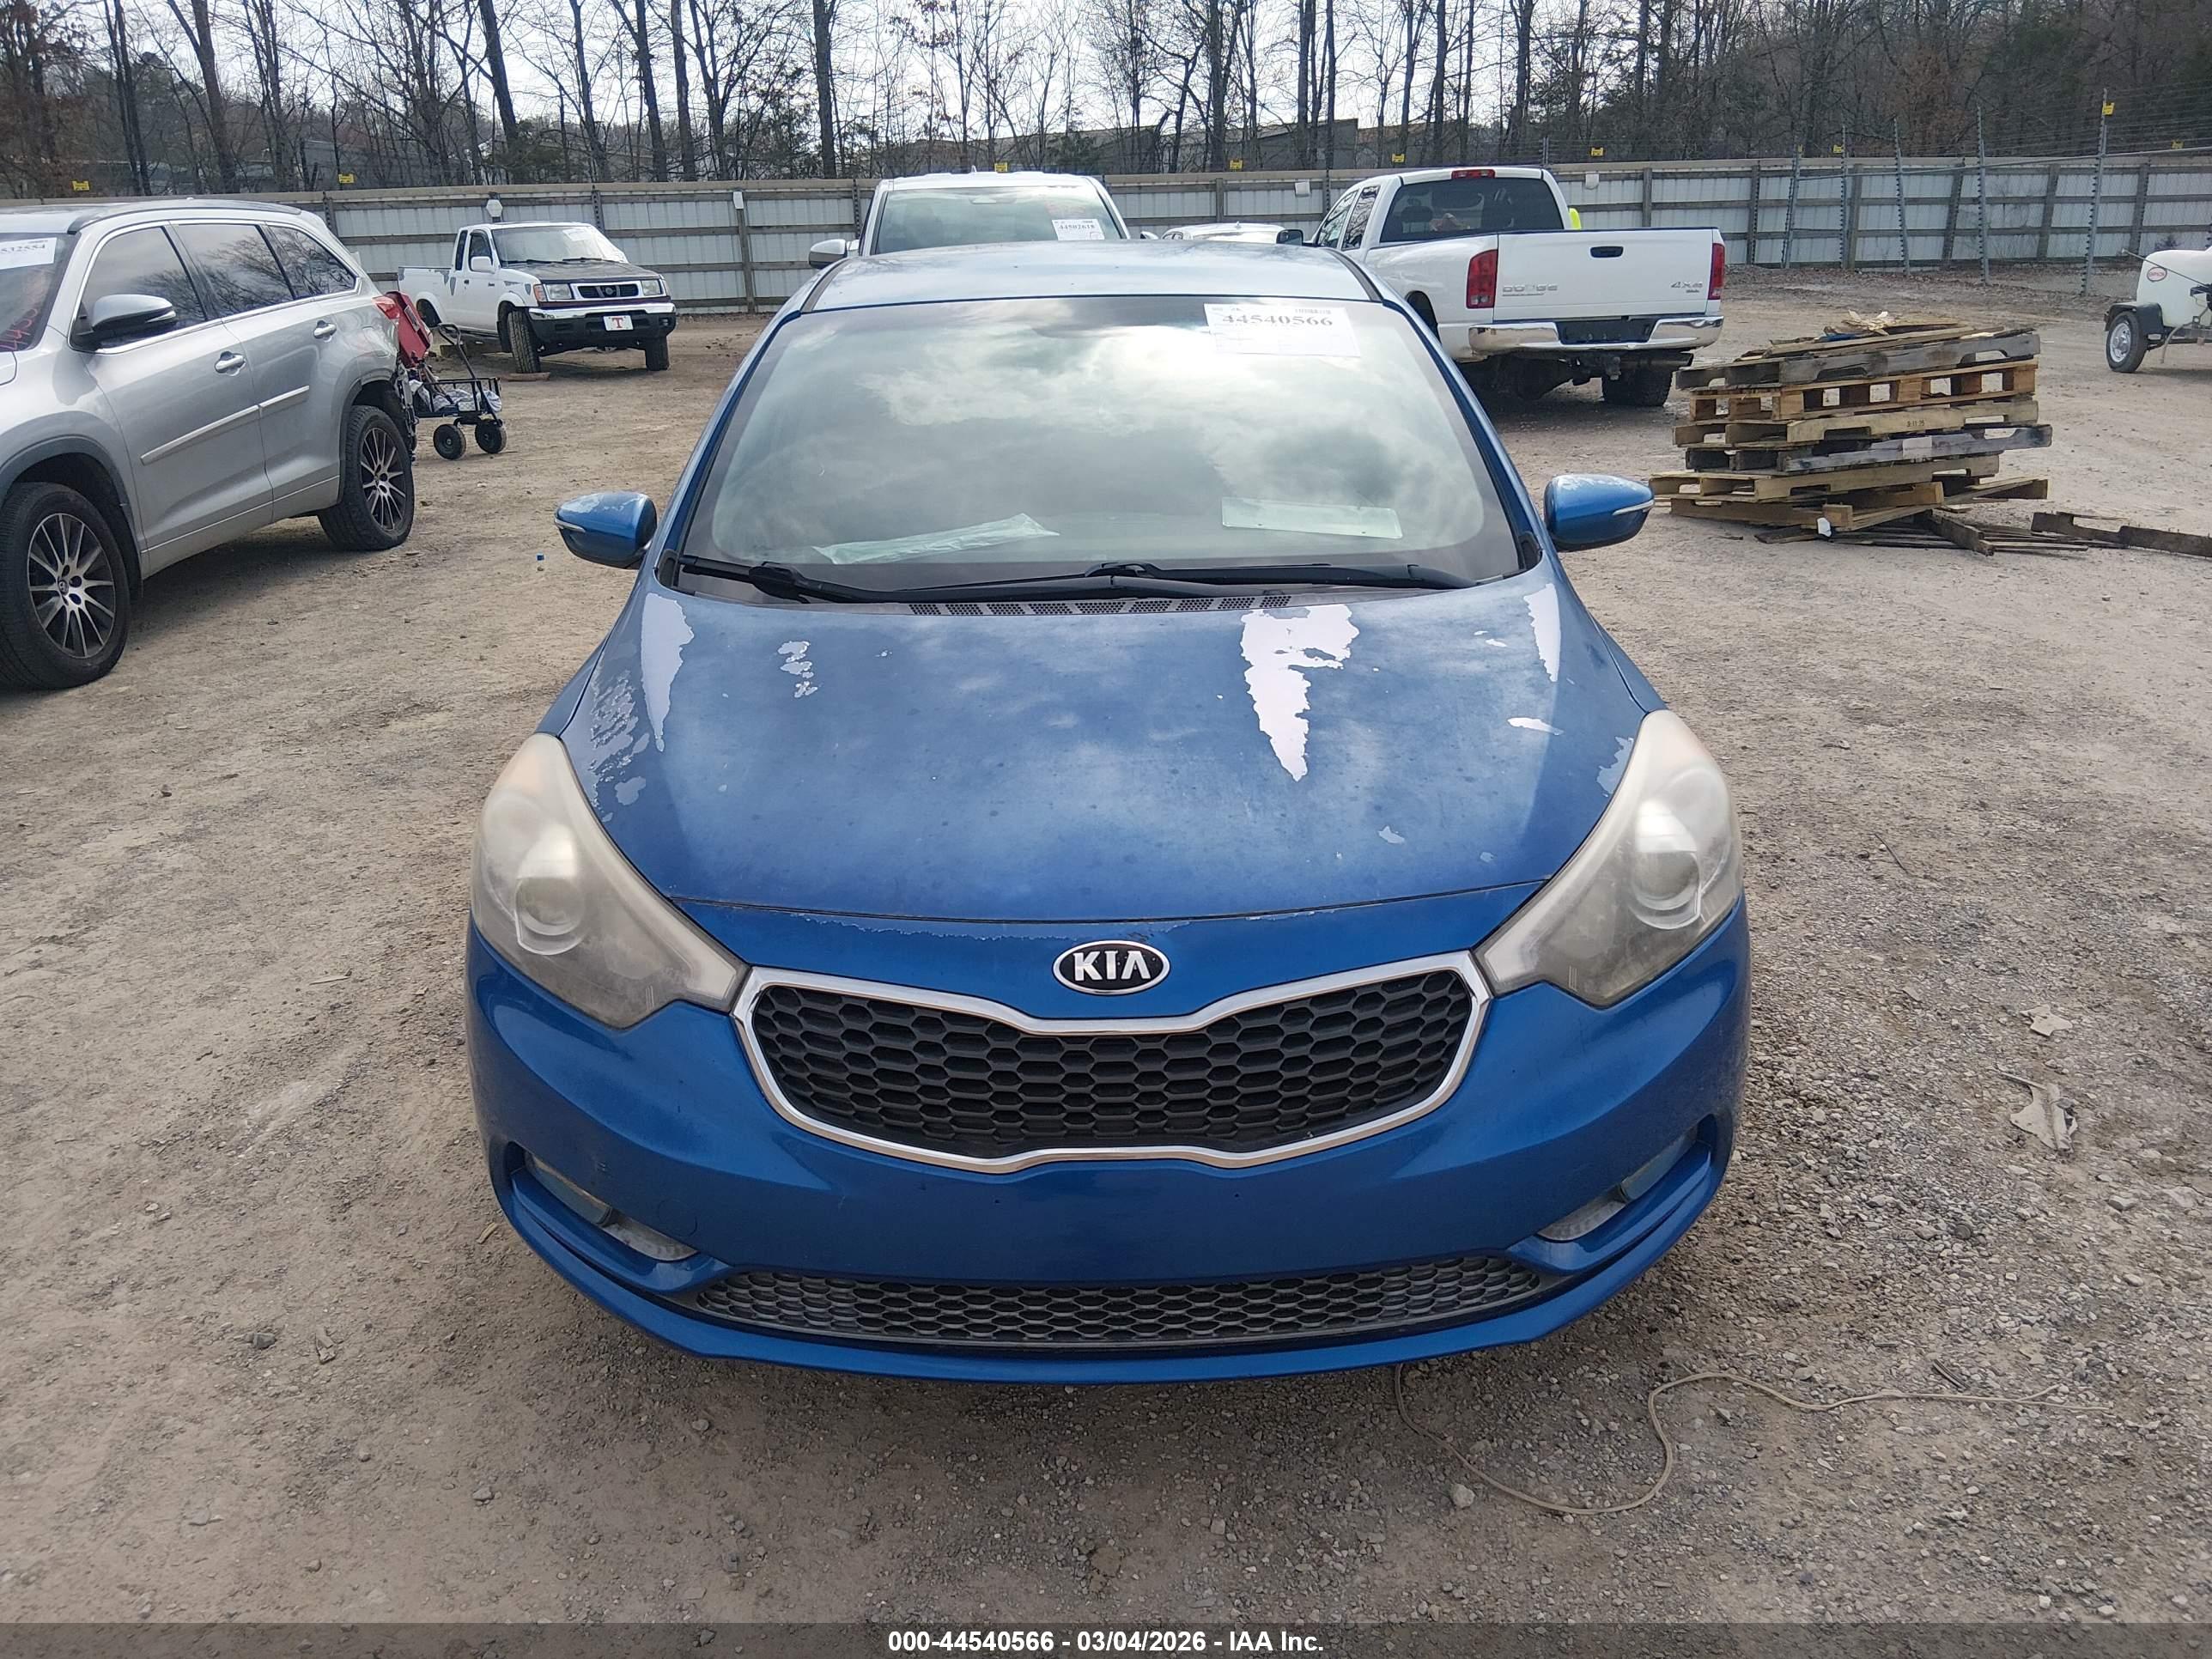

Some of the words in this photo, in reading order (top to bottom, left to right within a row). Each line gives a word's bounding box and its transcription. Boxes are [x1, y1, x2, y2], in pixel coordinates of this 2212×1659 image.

[1502, 284, 1559, 293] DOGE
[611, 317, 624, 328] T
[1222, 314, 1334, 326] 44540566
[1073, 950, 1151, 981] KIA
